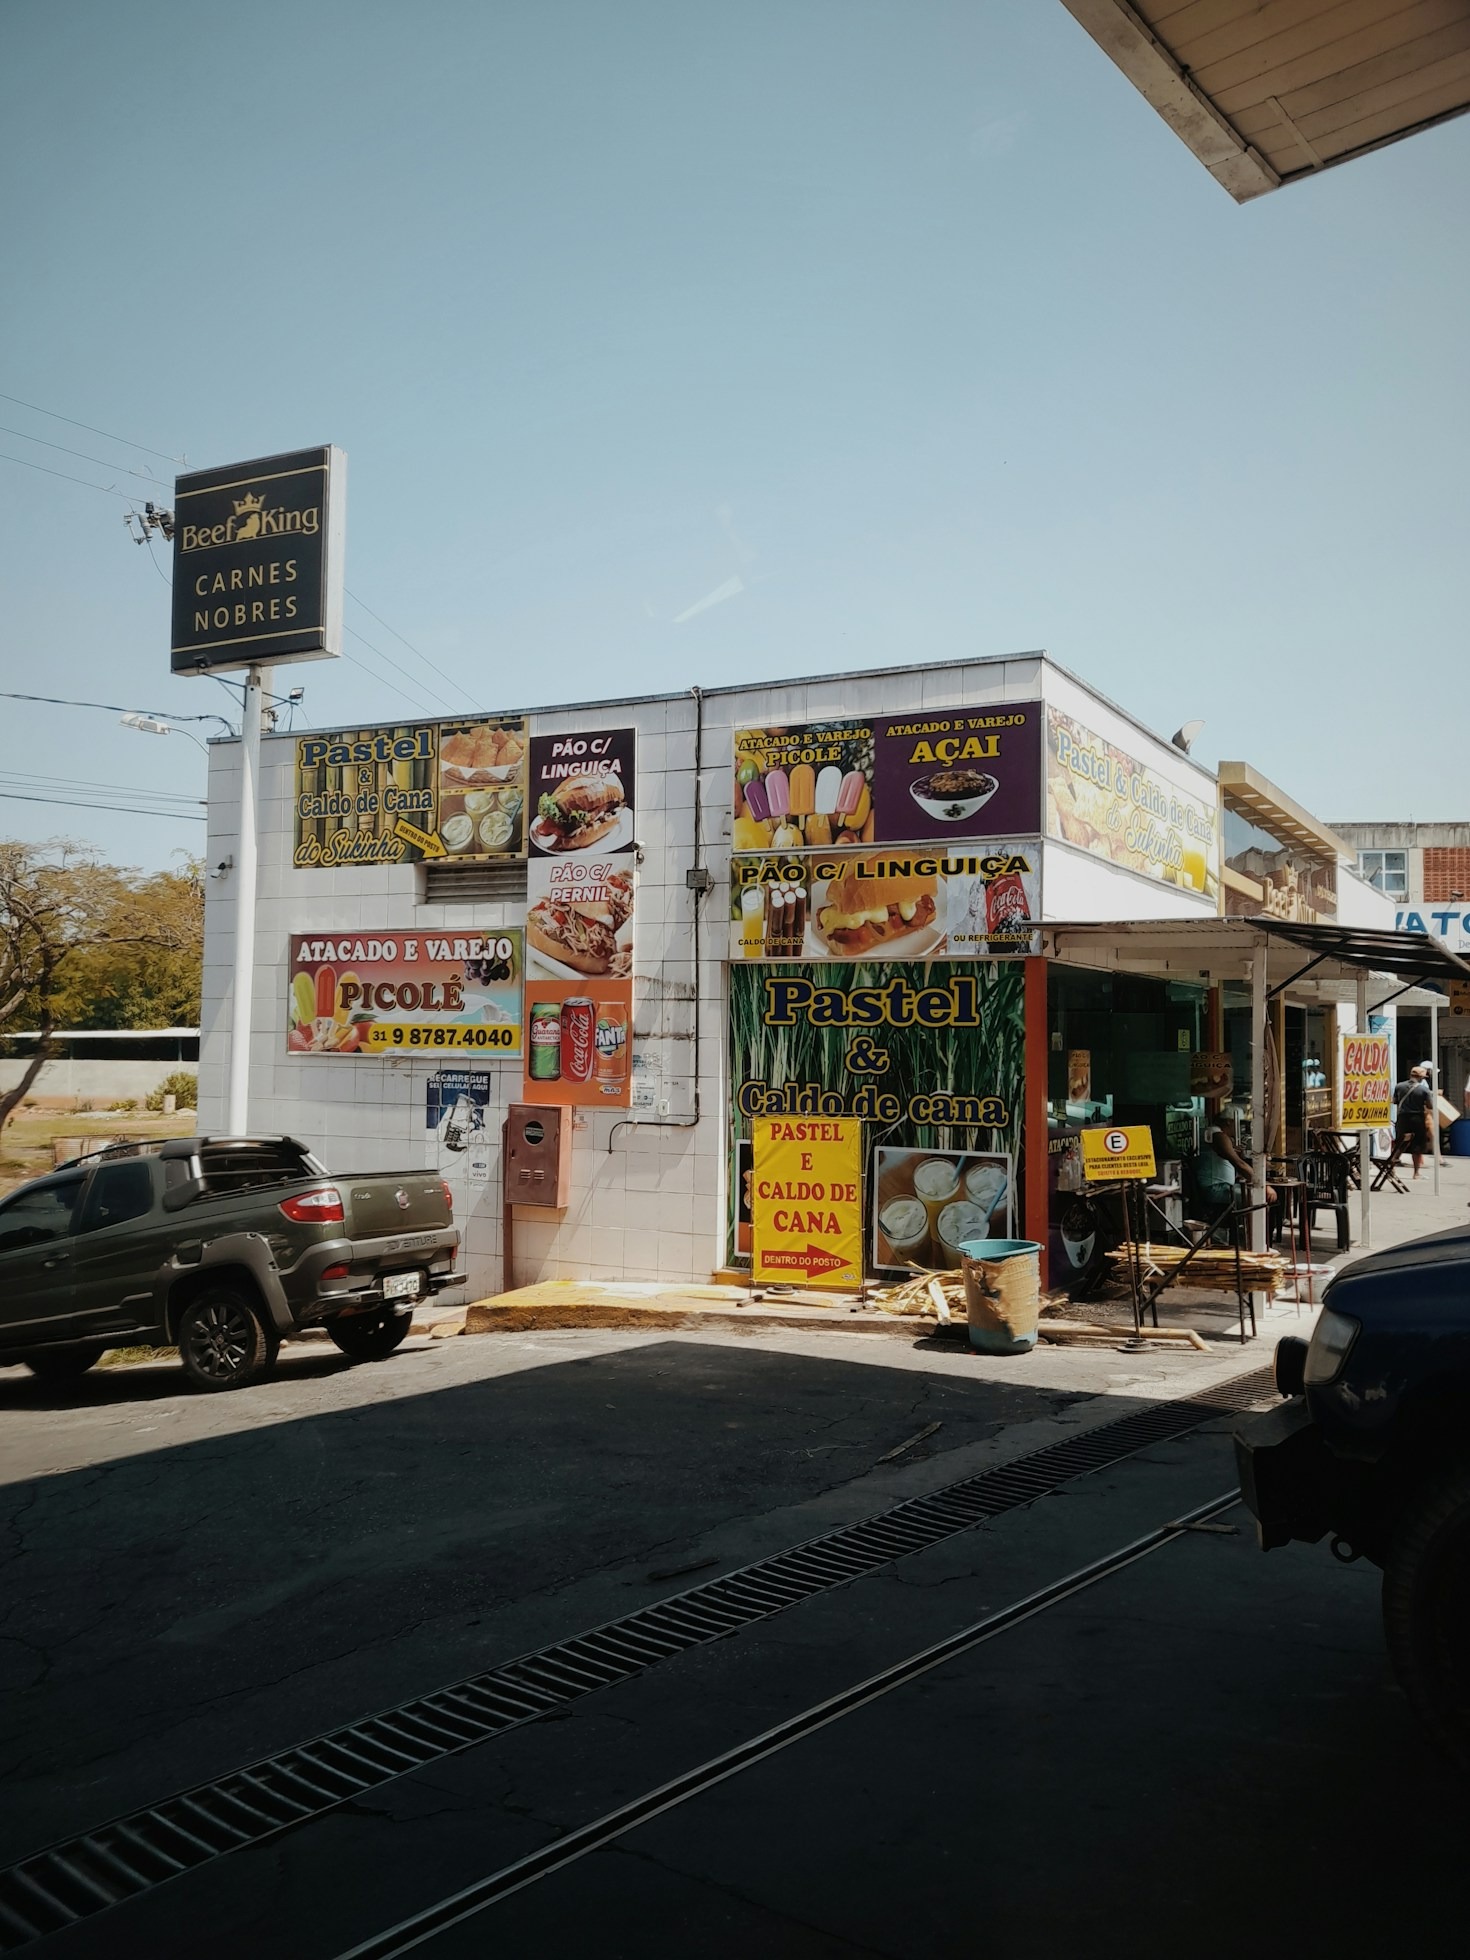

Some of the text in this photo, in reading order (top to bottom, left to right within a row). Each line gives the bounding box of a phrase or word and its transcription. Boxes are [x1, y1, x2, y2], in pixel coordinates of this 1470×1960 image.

[182, 507, 320, 551] Beef King
[195, 559, 297, 596] CARNES
[194, 596, 297, 632] NOBRES
[886, 714, 1026, 737] ATACADO E VAREJO
[300, 729, 434, 769] Pastel
[552, 737, 612, 758] PÃO C/
[739, 728, 871, 751] ATACADO E VAREJO
[766, 745, 842, 767] PICOLÉ
[358, 768, 373, 786] &
[541, 759, 622, 780] LINGUIÇA
[1056, 727, 1213, 845] Pastel & Caldo de Cana
[299, 785, 435, 820] Caldo de Cana
[400, 825, 440, 853] DENTRO DO POSTO
[1106, 801, 1184, 870] do Sukinha
[294, 828, 405, 867] do Sukinha
[550, 863, 612, 882] PÃO C/
[740, 855, 1030, 885] PÃO C/ LINGUIÇA
[550, 886, 610, 902] PERNIL
[738, 937, 805, 946] CALDO DE CANA
[953, 932, 1034, 943] OU REFRIGERANTE
[297, 938, 513, 962] ATACADO E VAREJO
[339, 974, 464, 1012] PICOLÉ
[765, 977, 981, 1027] Pastel
[372, 1028, 513, 1046] 31 9 8787.4040
[845, 1036, 890, 1074] &
[1345, 1041, 1389, 1075] CALDO
[472, 1083, 488, 1091] AQUI
[1344, 1081, 1360, 1101] DE
[738, 1081, 1008, 1127] Caldo de cana
[1343, 1108, 1354, 1120] DO
[770, 1123, 844, 1141] PASTEL
[1111, 1136, 1122, 1149] E
[801, 1152, 813, 1171] E
[472, 1170, 487, 1178] vivo
[758, 1181, 857, 1202] CALDO DE
[773, 1210, 842, 1234] CANA
[764, 1254, 841, 1268] DENTRO DO POSTO
